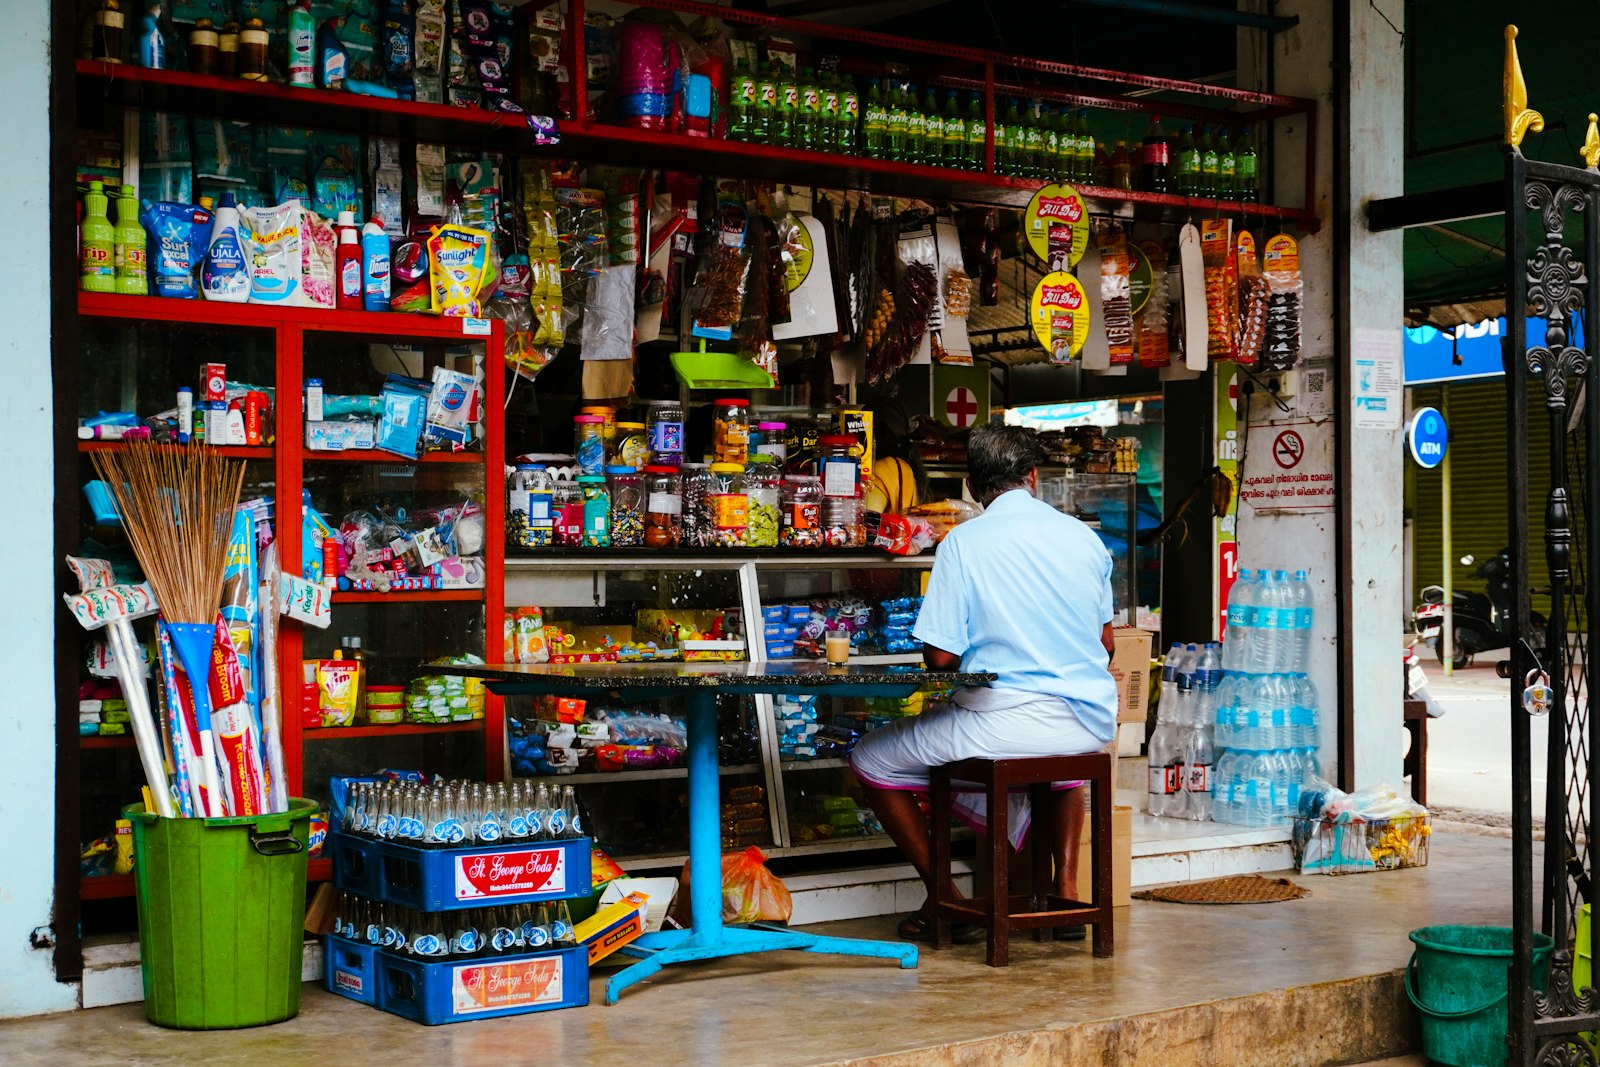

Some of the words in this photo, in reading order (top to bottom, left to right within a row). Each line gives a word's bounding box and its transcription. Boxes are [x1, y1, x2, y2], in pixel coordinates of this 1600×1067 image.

[1039, 203, 1059, 215] All
[1058, 203, 1081, 221] Day
[162, 237, 189, 251] Surf
[211, 248, 241, 258] UJALA
[437, 247, 476, 263] Sunlight
[1042, 291, 1059, 304] All
[1059, 291, 1080, 308] Day
[847, 421, 871, 429] White
[1420, 441, 1441, 455] ATM
[302, 585, 314, 613] Kerala
[517, 616, 543, 632] TANG
[215, 664, 231, 702] Broom
[325, 672, 350, 698] Vim
[469, 857, 486, 879] St.
[489, 855, 523, 883] George
[525, 853, 552, 874] Soda
[487, 966, 522, 994] George
[524, 963, 549, 985] Soda
